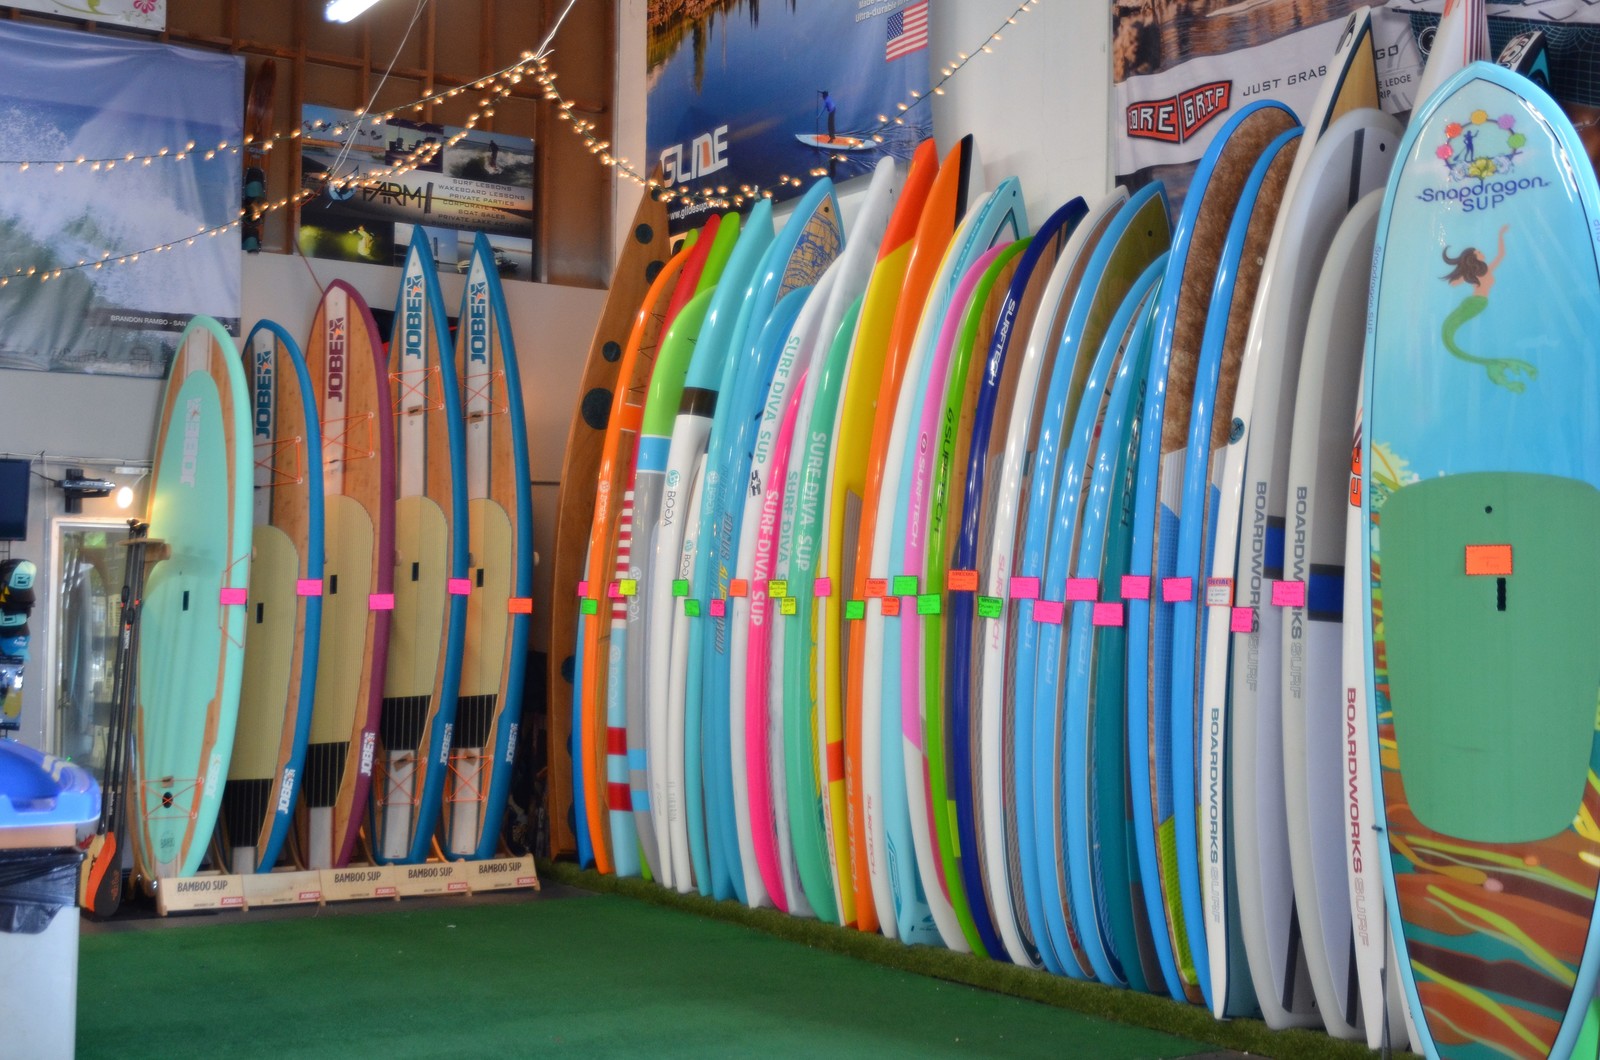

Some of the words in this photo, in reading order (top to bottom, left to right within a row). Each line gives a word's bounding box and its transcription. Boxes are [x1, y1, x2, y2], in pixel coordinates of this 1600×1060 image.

[1375, 44, 1399, 60] GO
[1242, 78, 1282, 97] JUST
[1287, 65, 1327, 85] GRAB
[1379, 89, 1392, 100] RIP
[1385, 74, 1412, 88] LEDGE
[1182, 87, 1225, 127] GRIP
[660, 125, 729, 188] GLIDE
[363, 180, 422, 208] FARM
[438, 184, 487, 197] WAKEBOARD
[489, 191, 526, 201] LESSONS
[449, 193, 481, 203] PRIVATE
[483, 197, 515, 207] PARTIES
[452, 178, 474, 187] SURF
[475, 181, 512, 192] LESSONS
[1420, 176, 1546, 204] Snapdragon
[1462, 194, 1505, 213] SUP
[438, 213, 470, 223] PRIVATE
[668, 198, 723, 220] ww.glidesup.m
[110, 314, 143, 324] BRANDON
[144, 316, 169, 326] RAMBO
[173, 319, 187, 328] SAN
[405, 296, 424, 360] JOBE
[470, 301, 487, 365] JOBE
[778, 336, 800, 379] SURF
[988, 298, 1016, 387] SURFTECH
[327, 336, 345, 402] JOBE
[255, 372, 272, 439] JOBE
[764, 381, 786, 422] DIVA
[755, 430, 771, 465] SUP
[808, 431, 827, 480] SURF
[760, 489, 779, 535] SURF
[783, 470, 798, 517] SURF
[801, 483, 820, 527] DIVA
[911, 457, 926, 548] SURFTECH
[753, 538, 772, 582] DIVA
[778, 521, 794, 564] DIVA
[796, 534, 813, 572] SUP
[1249, 481, 1267, 634] BOARDWORKS
[1291, 486, 1308, 639] BOARDWKS
[750, 590, 765, 626] SUP
[1246, 635, 1261, 692] SURF
[1289, 642, 1302, 699] SURF
[360, 743, 375, 777] JOBE
[277, 779, 294, 815] JOBE
[1210, 707, 1220, 865] BOARDWORKS
[1347, 687, 1363, 874] BOARDWORKS
[866, 794, 877, 875] SURFTECH
[177, 881, 212, 892] BAMBOO
[212, 879, 228, 891] SUP
[334, 872, 366, 883] BAMBOO
[366, 871, 382, 881] SUP
[408, 868, 439, 879] BAMBOO
[439, 866, 453, 877] SUP
[478, 863, 508, 874] BAMBOO
[508, 861, 522, 872] SUP
[1354, 877, 1369, 947] SURF
